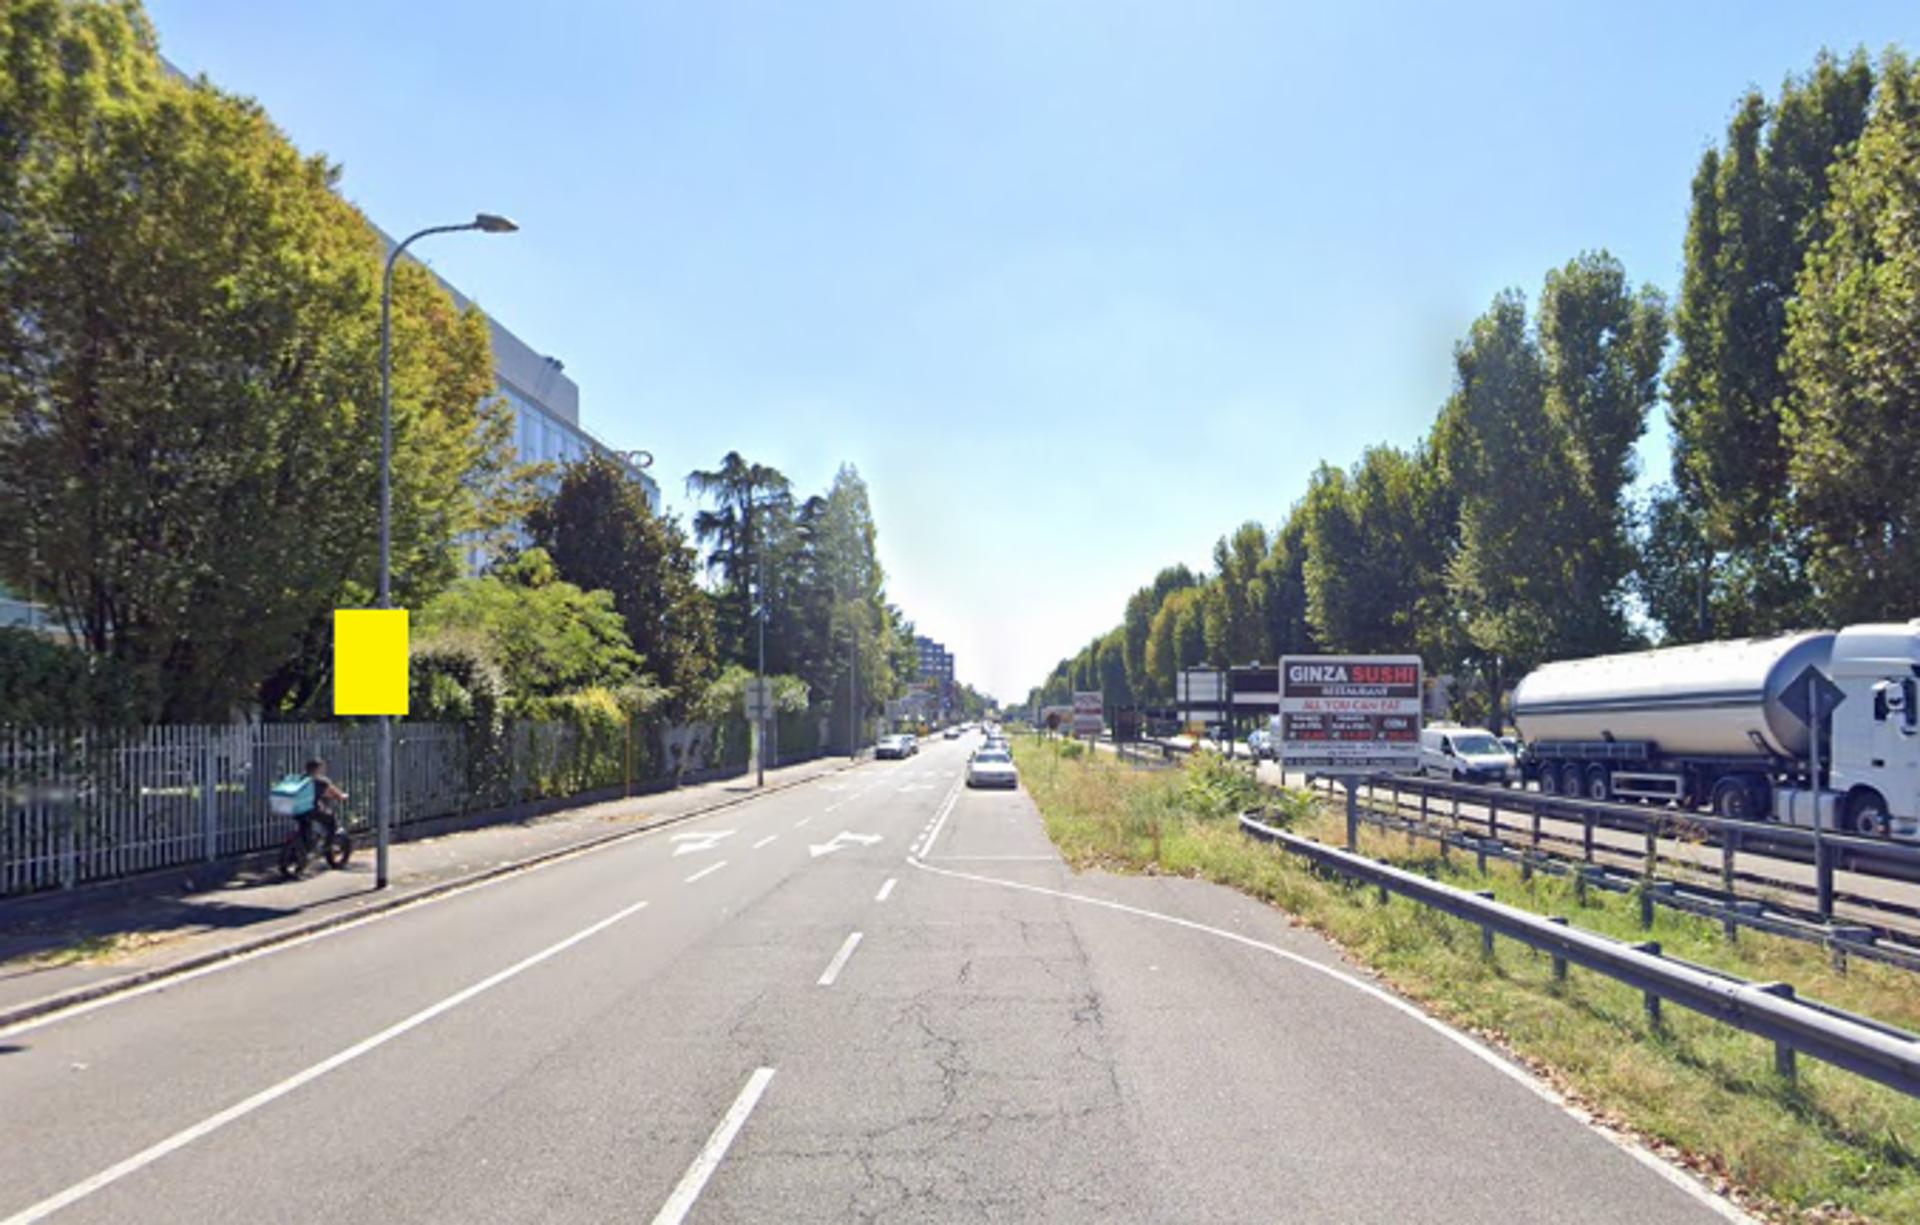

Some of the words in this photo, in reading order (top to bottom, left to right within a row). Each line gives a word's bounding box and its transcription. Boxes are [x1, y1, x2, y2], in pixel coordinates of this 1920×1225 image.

[1289, 665, 1348, 682] GINZA
[1352, 666, 1416, 683] SUSHI
[1303, 699, 1321, 710] ALL
[1325, 699, 1350, 710] YOU
[1381, 699, 1400, 710] EAT
